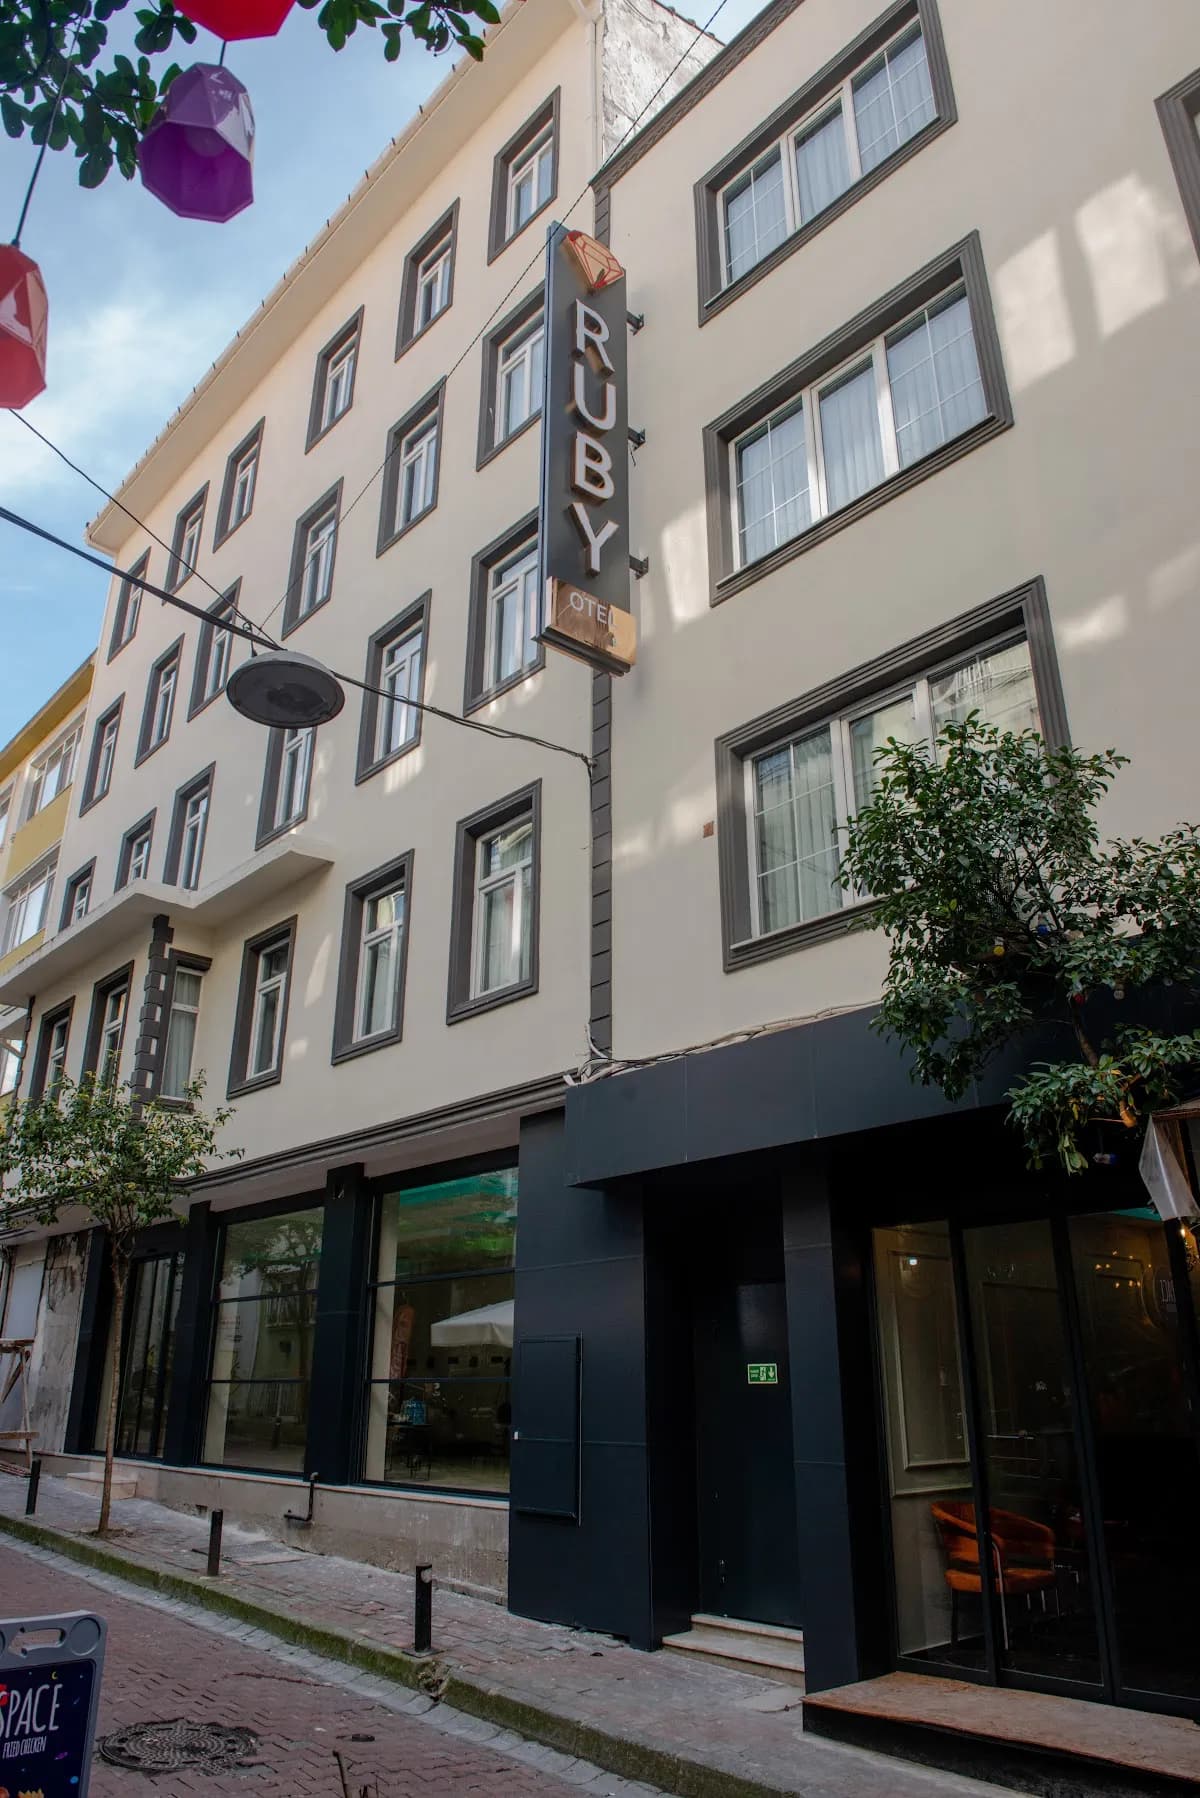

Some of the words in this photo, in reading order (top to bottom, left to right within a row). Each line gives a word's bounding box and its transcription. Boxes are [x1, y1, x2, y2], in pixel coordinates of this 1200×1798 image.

[571, 299, 619, 577] RUBY
[2, 1741, 20, 1759] FRIED
[20, 1736, 46, 1756] CHICKEN
